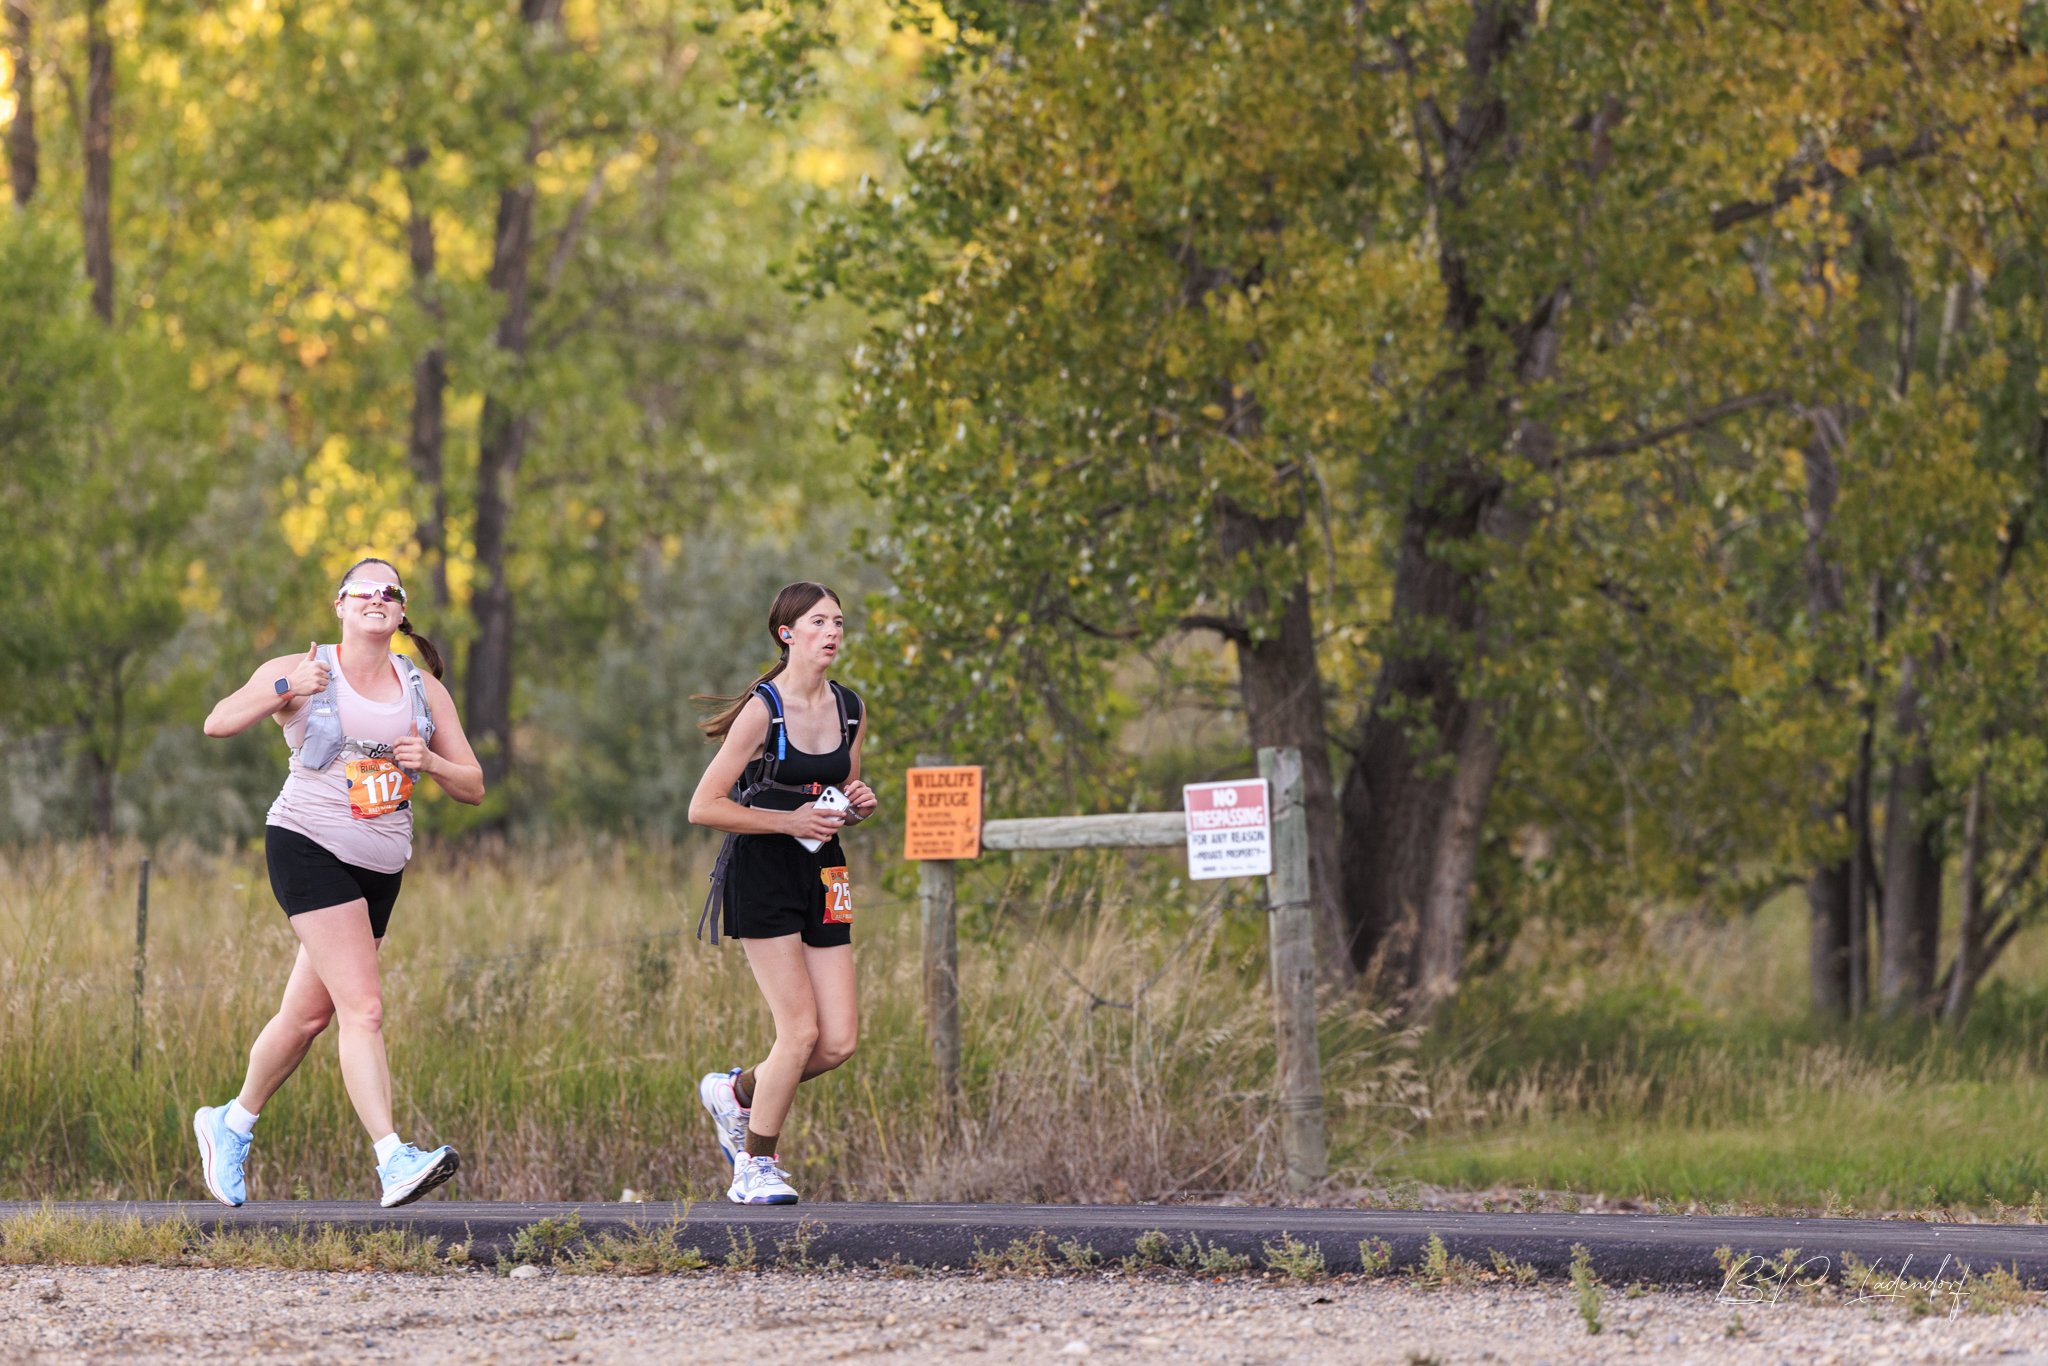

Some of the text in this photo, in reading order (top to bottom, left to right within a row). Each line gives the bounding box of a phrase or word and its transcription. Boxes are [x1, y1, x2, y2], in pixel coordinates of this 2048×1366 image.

[362, 771, 403, 805] 112
[912, 772, 974, 788] WILDLIFE
[917, 792, 969, 808] REFUGE
[1212, 788, 1238, 808] NO
[1191, 806, 1264, 831] TRESPASSING
[1192, 830, 1265, 846] FOR ANY REASON
[832, 882, 852, 911] 25
